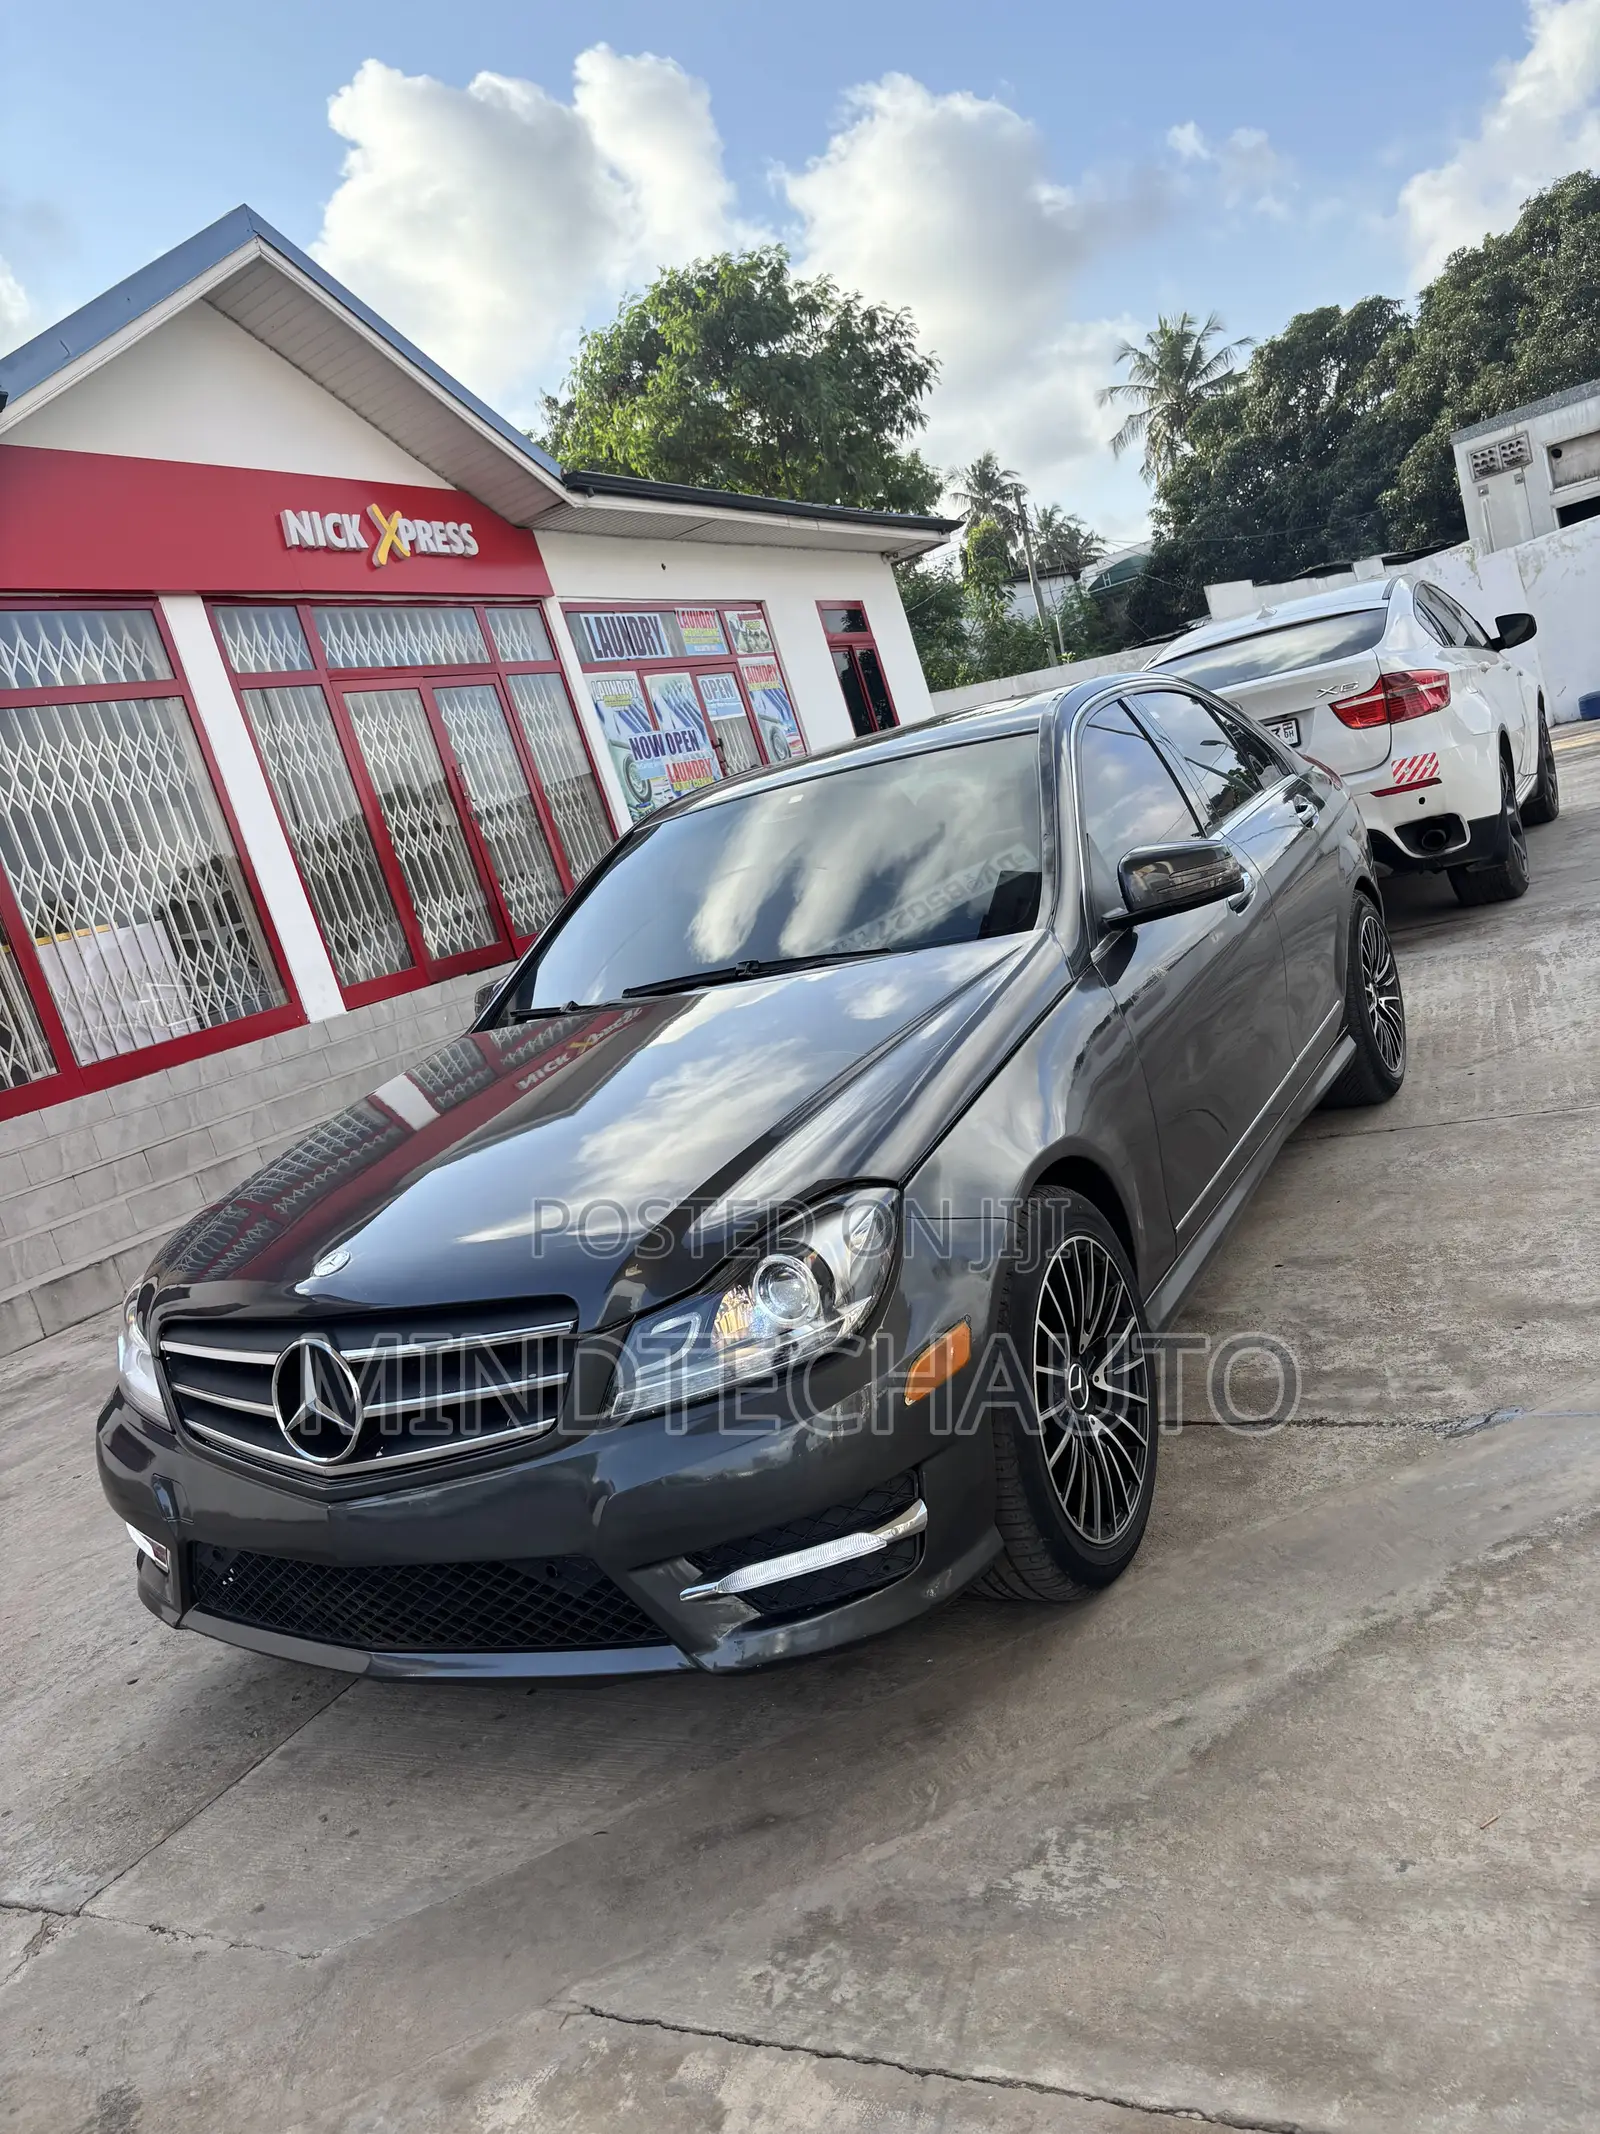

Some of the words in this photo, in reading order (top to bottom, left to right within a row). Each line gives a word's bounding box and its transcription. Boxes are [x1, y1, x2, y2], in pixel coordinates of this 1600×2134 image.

[280, 509, 369, 551] NICK
[366, 503, 480, 568] XPRESS
[675, 610, 719, 629] LAUNDRY
[583, 615, 666, 659] LAUNDRY
[742, 663, 778, 684] LAUNDRY
[590, 678, 639, 701] LAUNDRY
[700, 677, 736, 701] OPEN
[629, 733, 667, 760] NOW
[665, 729, 701, 755] OPEN
[666, 758, 713, 784] LAUNDRY
